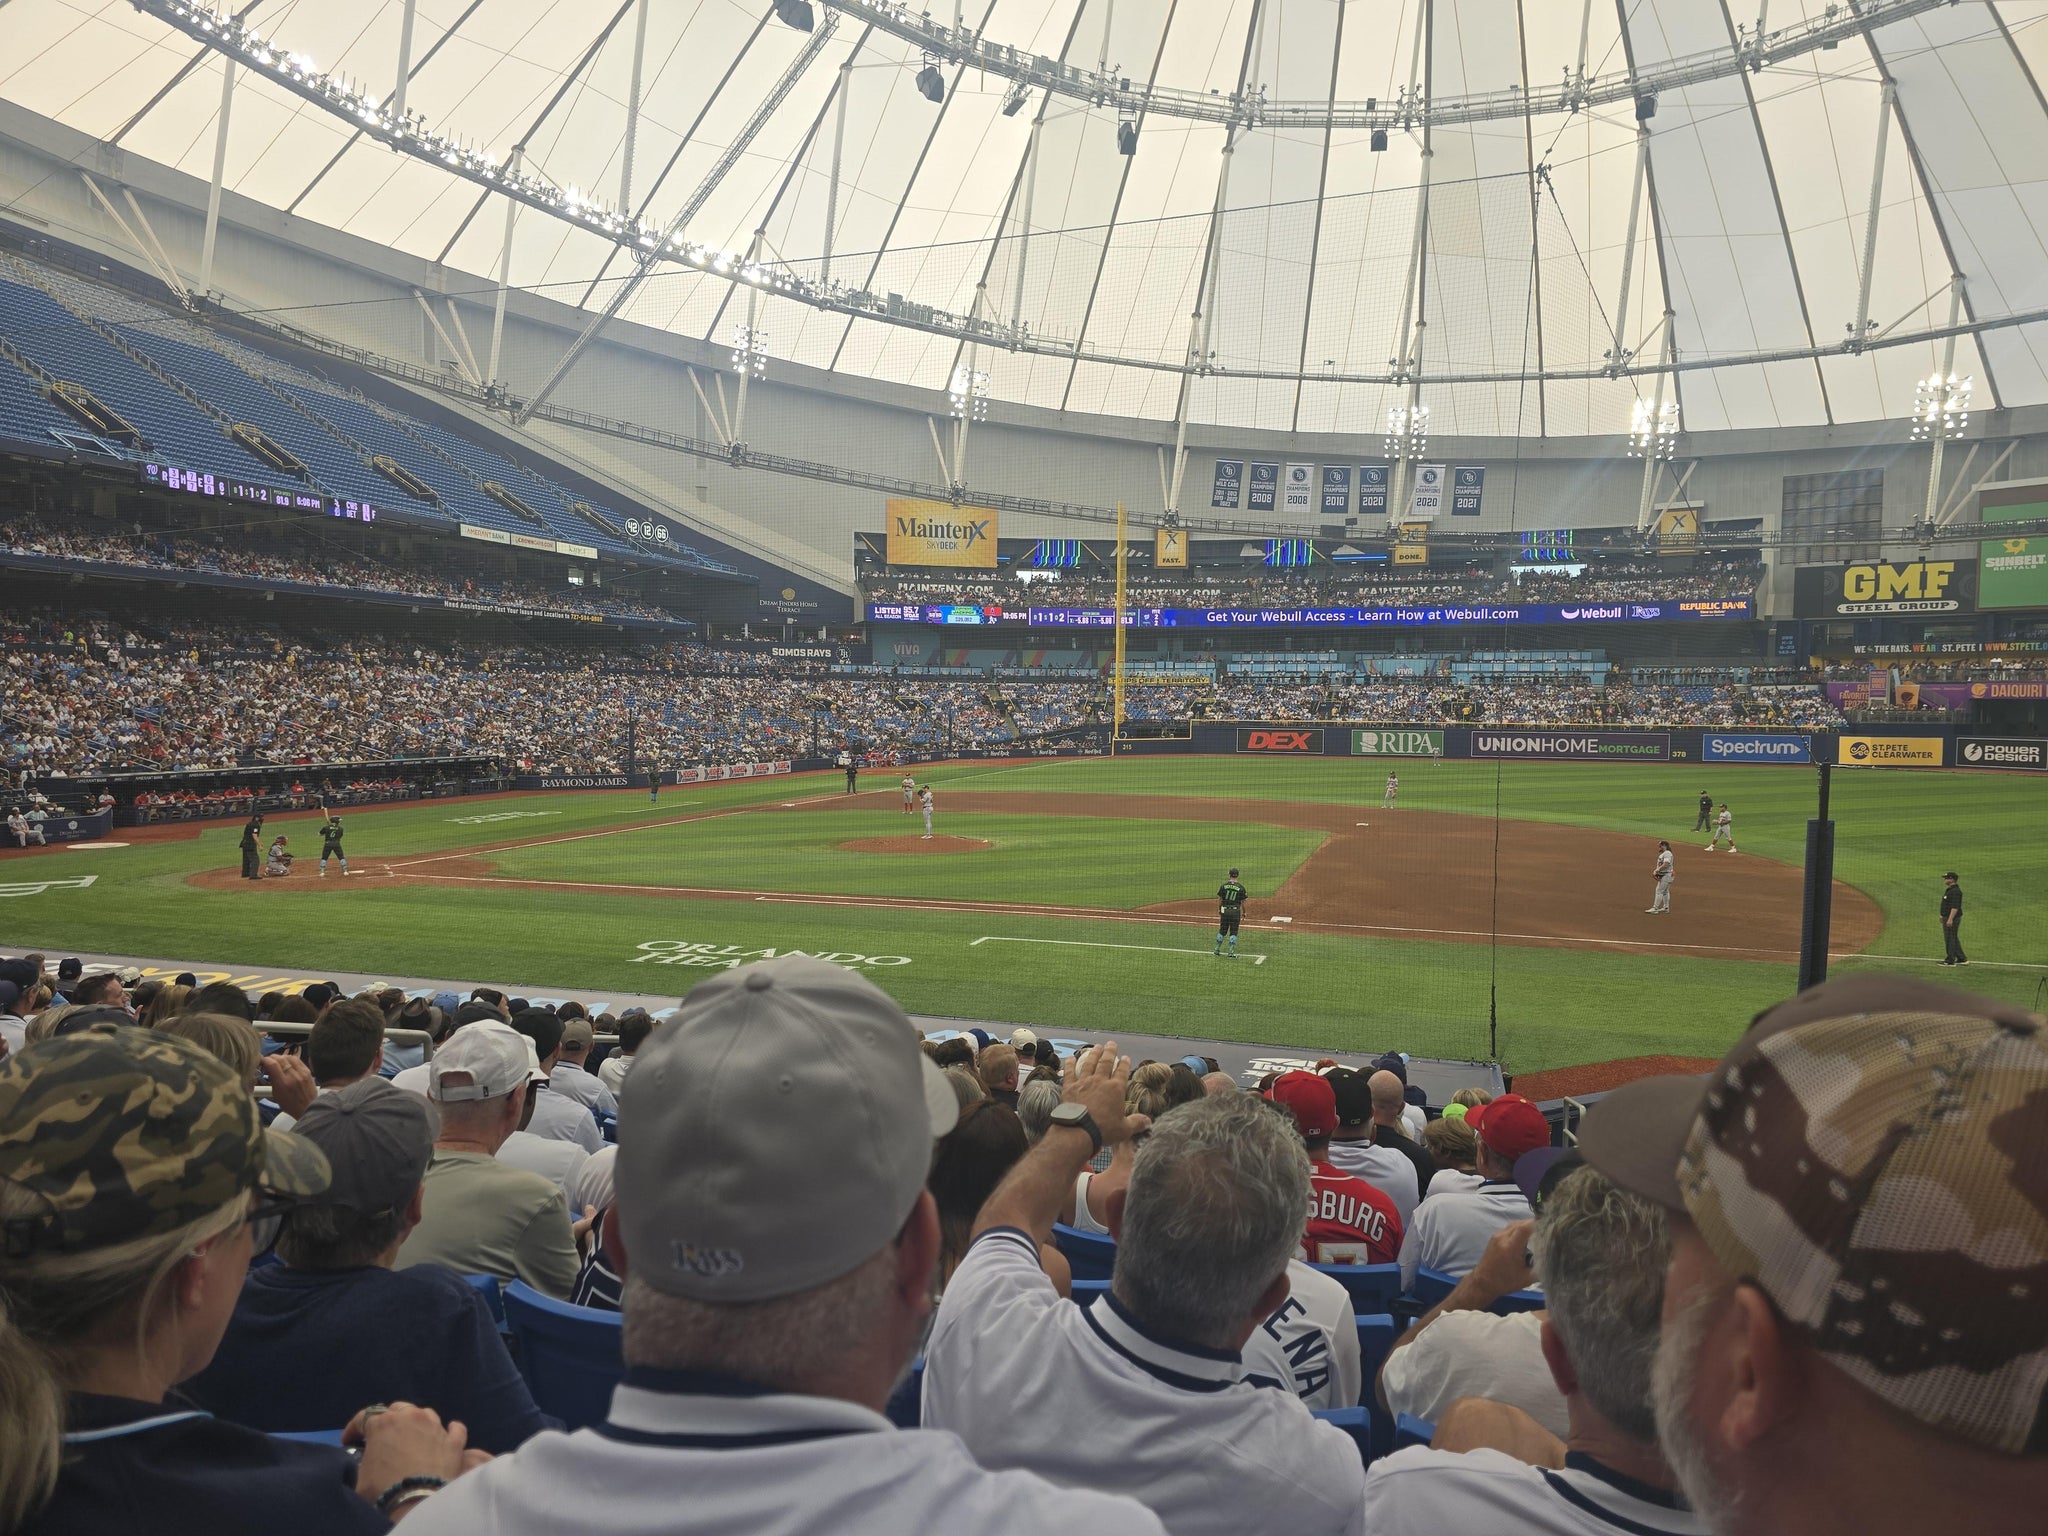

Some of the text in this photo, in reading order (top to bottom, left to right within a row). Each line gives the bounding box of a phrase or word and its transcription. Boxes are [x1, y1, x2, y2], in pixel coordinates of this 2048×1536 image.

[162, 471, 203, 487] R H E
[239, 485, 244, 496] 1
[250, 487, 254, 498] 1
[260, 489, 267, 500] 2
[1251, 483, 1275, 491] CHAMPIONS
[1251, 493, 1272, 503] 2008
[1287, 495, 1308, 505] 2008
[1325, 496, 1345, 506] 2010
[1362, 496, 1384, 506] 2020
[1416, 497, 1438, 507] 2020
[1457, 498, 1477, 508] 2021
[311, 499, 320, 509] PM
[346, 501, 358, 510] CWS
[371, 509, 376, 519] F
[643, 524, 652, 537] 12
[657, 527, 667, 540] 66
[895, 516, 989, 549] MaintenX
[926, 540, 958, 550] SKYDECK
[1843, 561, 1955, 601] GMF
[444, 600, 459, 609] Need
[494, 605, 506, 613] Text
[507, 607, 519, 615] Your
[874, 606, 901, 614] LISTEN
[903, 606, 919, 614] 95.7
[1679, 601, 1747, 611] REPUBLIC BANK
[1845, 601, 1950, 612] STEEL GROUP
[1002, 612, 1027, 620] 10:05 PM
[1038, 613, 1043, 622] 1
[1049, 613, 1054, 622] 1
[1058, 613, 1065, 622] 2
[1206, 611, 1228, 623] Get
[1231, 611, 1258, 623] Your
[1261, 610, 1302, 623] Webull
[1305, 610, 1346, 622] Access
[1357, 609, 1392, 622] Learn
[1396, 609, 1424, 621] How
[1428, 610, 1441, 620] at
[1444, 608, 1519, 620] Webull.com
[1581, 606, 1622, 619] Webull
[772, 647, 832, 658] SOMOS RAYS
[893, 643, 920, 655] VIVA
[1854, 645, 1867, 654] WE
[1874, 644, 1890, 653] THE
[1890, 643, 1913, 653] RAYS.
[1912, 643, 1925, 652] WE
[1941, 643, 1955, 652] ST.
[1955, 642, 1976, 652] PETE
[1990, 684, 2043, 698] DAIQUIRI
[1247, 732, 1313, 750] DEX
[1380, 732, 1437, 754] RIPA
[1598, 745, 1661, 755] MORTGAGE
[1711, 739, 1794, 757] Spectrum
[1871, 751, 1934, 759] CLEARWATER
[541, 777, 628, 788] RAYMOND JAMES
[636, 940, 913, 966] ORLANDO
